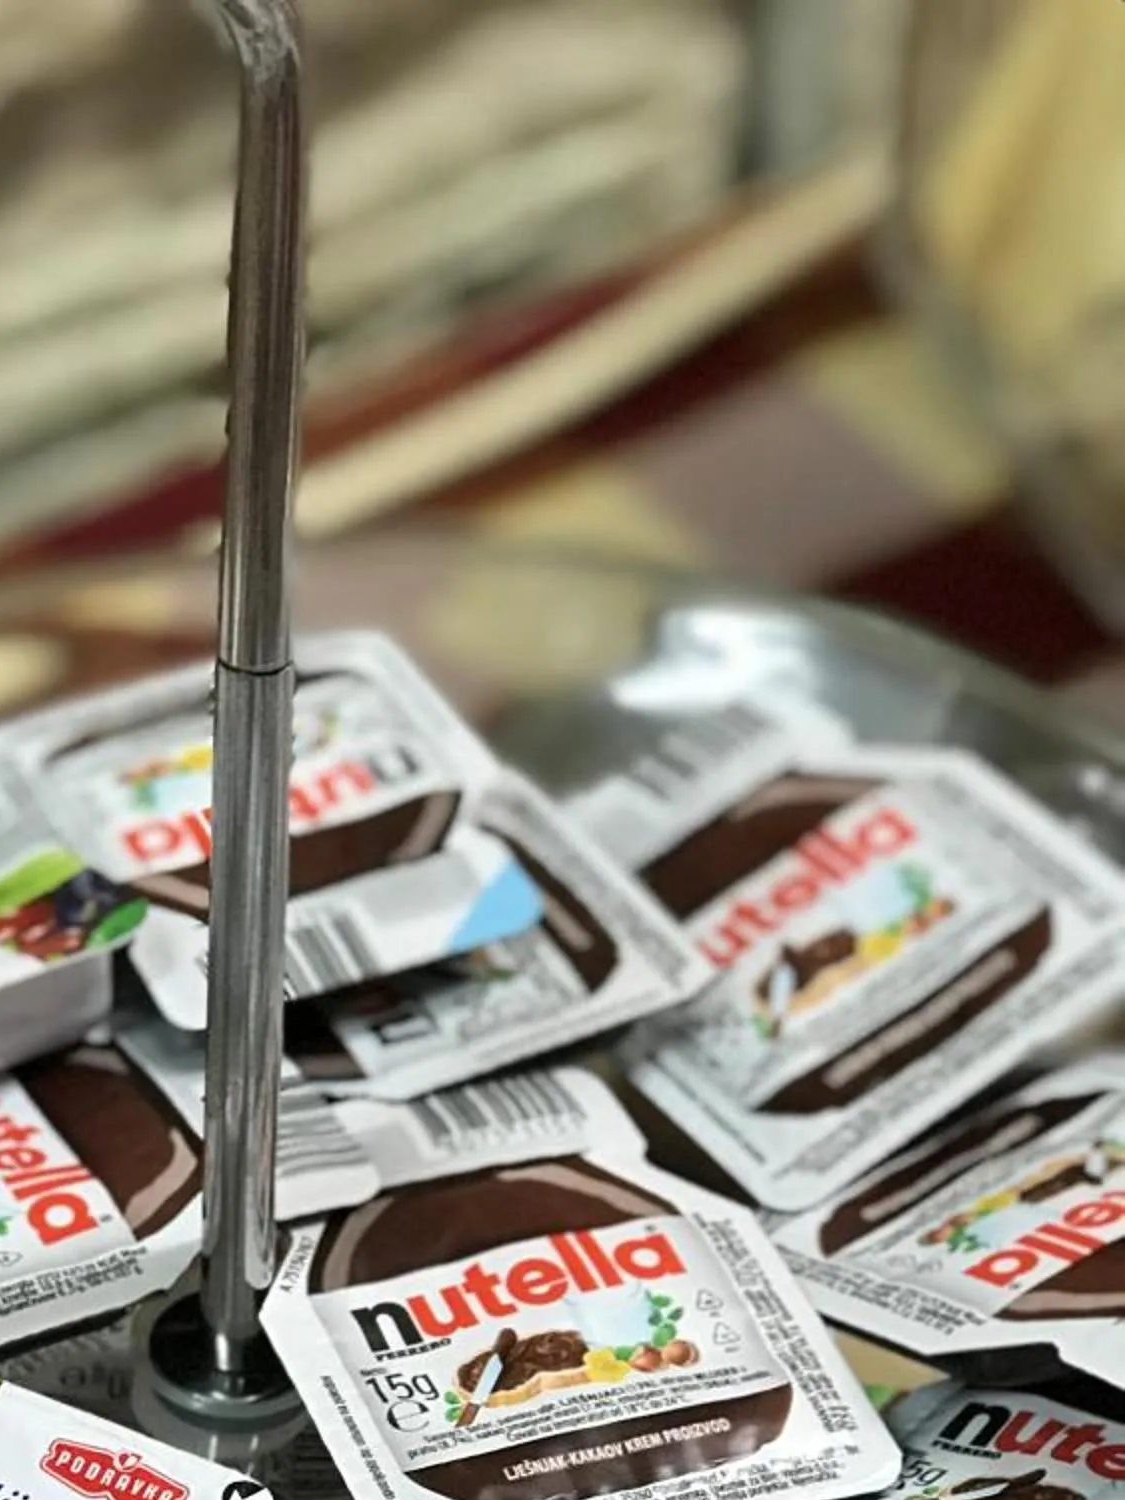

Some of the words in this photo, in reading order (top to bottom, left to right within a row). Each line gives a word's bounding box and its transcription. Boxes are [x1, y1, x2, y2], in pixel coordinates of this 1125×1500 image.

[122, 744, 421, 862] nutla
[694, 807, 918, 970] utella
[963, 1188, 1125, 1289] ella
[350, 1225, 687, 1352] nutella
[365, 1373, 438, 1403] 15g
[504, 1443, 623, 1480] LJEŠNJAK-KAKAOV
[624, 1433, 662, 1452] KREM
[663, 1418, 731, 1442] PROIZVOD
[909, 1454, 943, 1489] 5g
[939, 1400, 1125, 1481] nute
